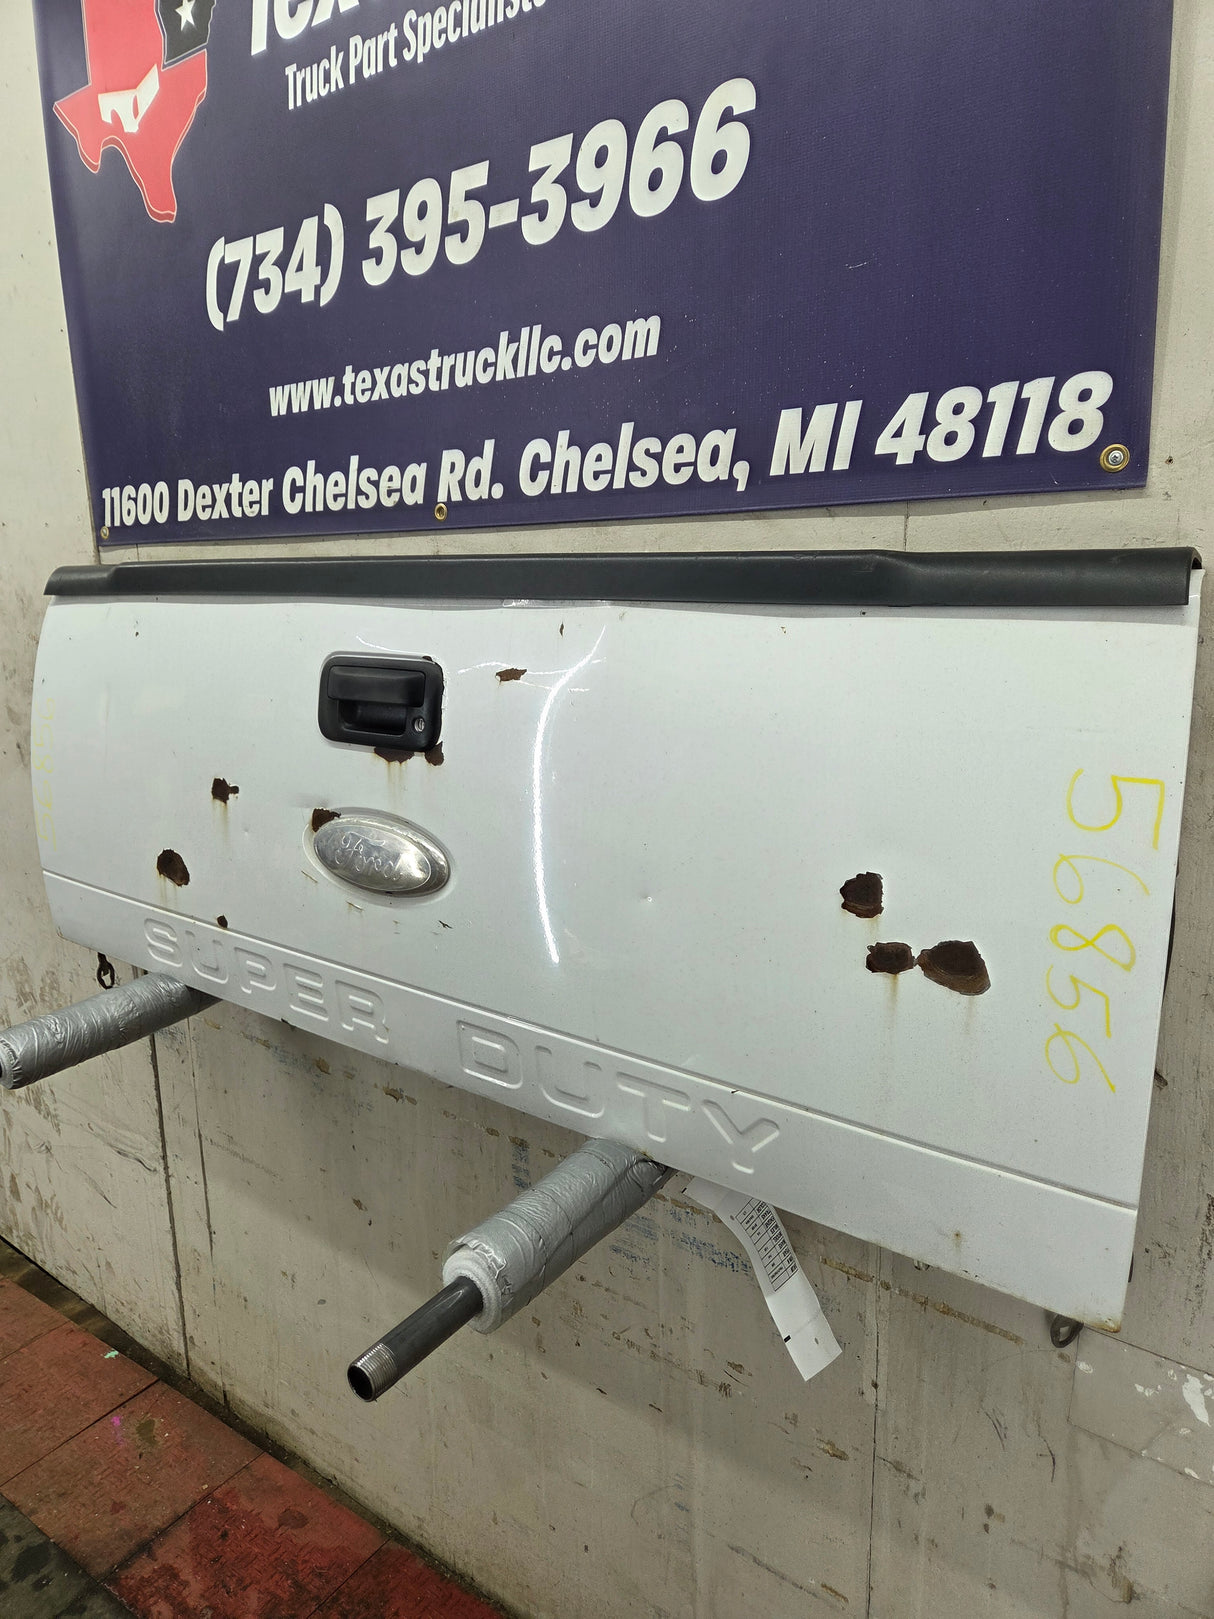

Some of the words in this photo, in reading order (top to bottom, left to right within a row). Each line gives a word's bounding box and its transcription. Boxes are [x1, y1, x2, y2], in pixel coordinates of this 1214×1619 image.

[285, 45, 345, 110] Truck
[349, 23, 399, 85] Part
[402, 0, 547, 64] Specia
[206, 203, 345, 331] (734)
[361, 78, 757, 287] 395-3966
[102, 481, 170, 528] 11600
[177, 473, 274, 522] Dexter
[283, 454, 428, 515] Chelsea
[438, 438, 504, 503] Rd.
[518, 421, 750, 500] Chelsea,
[769, 399, 863, 477] MI
[874, 370, 1114, 466] 48118
[268, 315, 661, 417] www.texastruckllc.com
[1045, 767, 1166, 1094] 56856
[143, 916, 390, 1045] SUPER
[456, 1018, 780, 1175] DUTY
